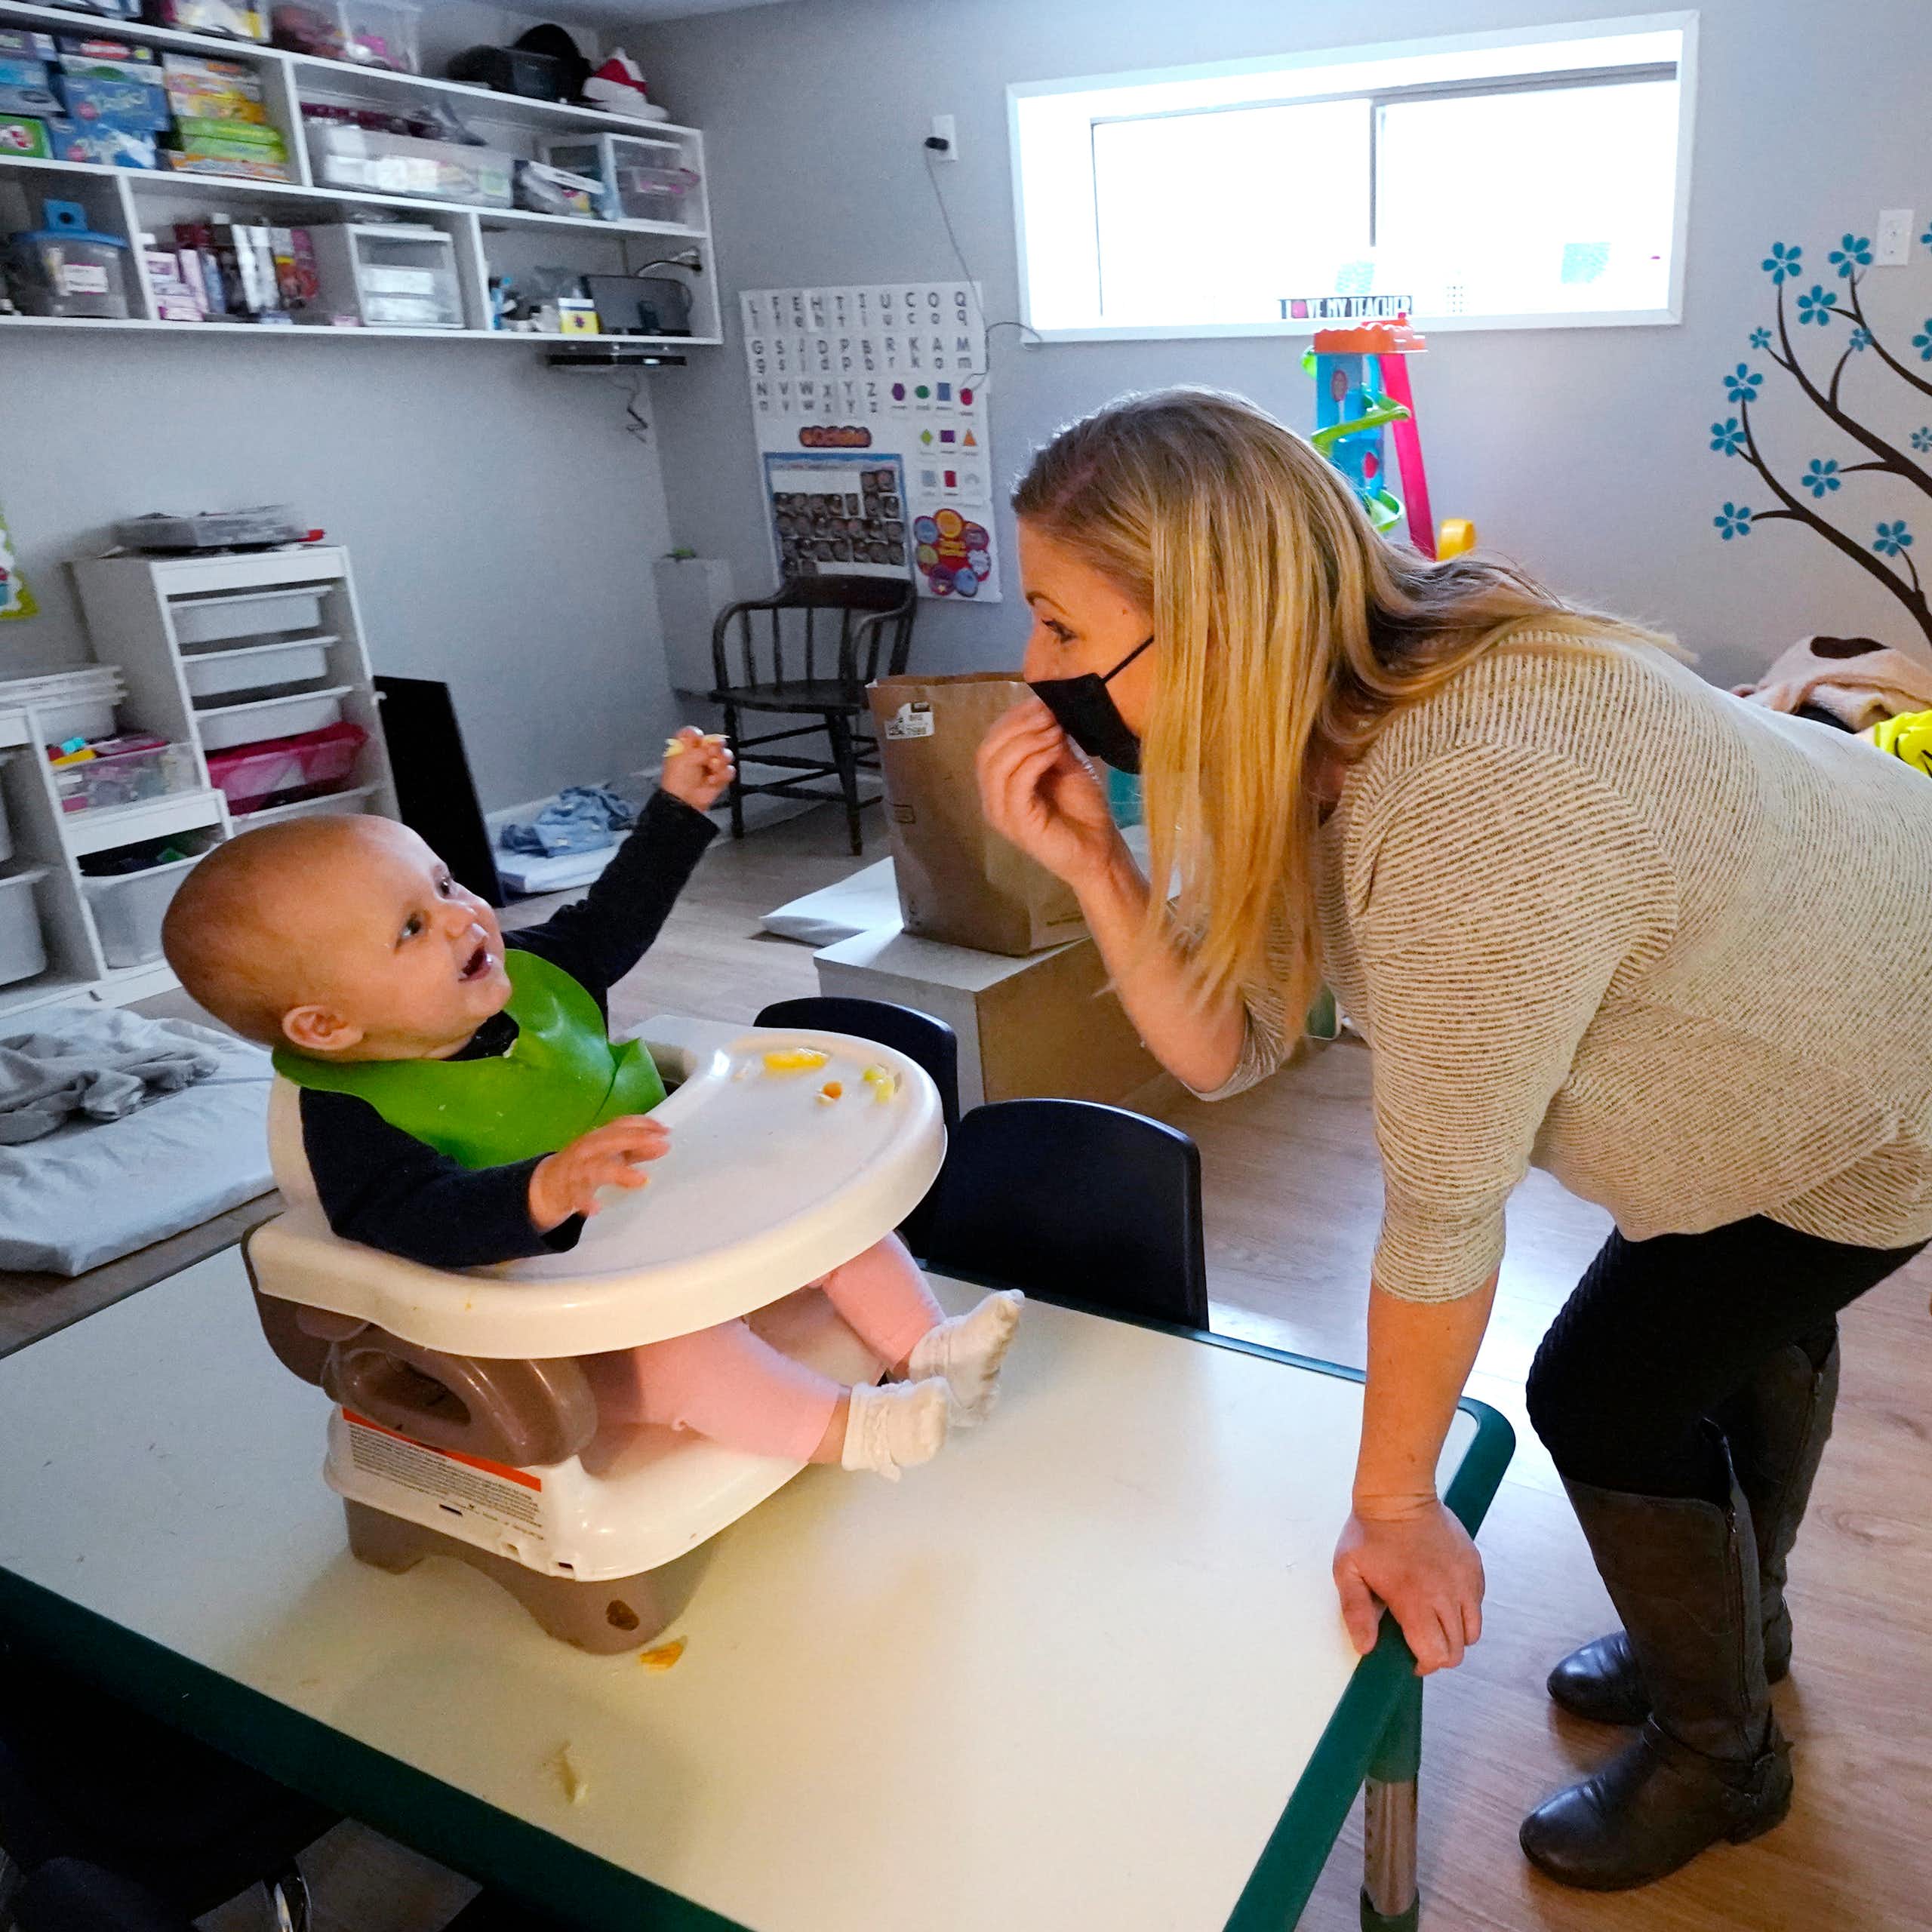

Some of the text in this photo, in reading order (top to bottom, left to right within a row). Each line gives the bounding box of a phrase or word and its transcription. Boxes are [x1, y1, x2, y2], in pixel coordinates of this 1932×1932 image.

[793, 296, 801, 311] E
[811, 296, 822, 311] H
[835, 295, 844, 310] T
[859, 293, 866, 308] I
[881, 293, 891, 309] U
[906, 292, 916, 308] C
[928, 292, 939, 308] O
[954, 291, 967, 307] Q
[1327, 297, 1348, 318] MY
[907, 312, 915, 325] c
[957, 309, 968, 326] q
[752, 340, 764, 355] G
[776, 340, 784, 355] S
[818, 340, 829, 354] D
[886, 337, 896, 351] R
[909, 337, 919, 351] K
[933, 337, 943, 352] A
[956, 337, 971, 352] M
[756, 381, 768, 395] N
[779, 382, 789, 395] V
[798, 380, 814, 395] W
[843, 381, 854, 395] Y
[867, 382, 877, 396] Z
